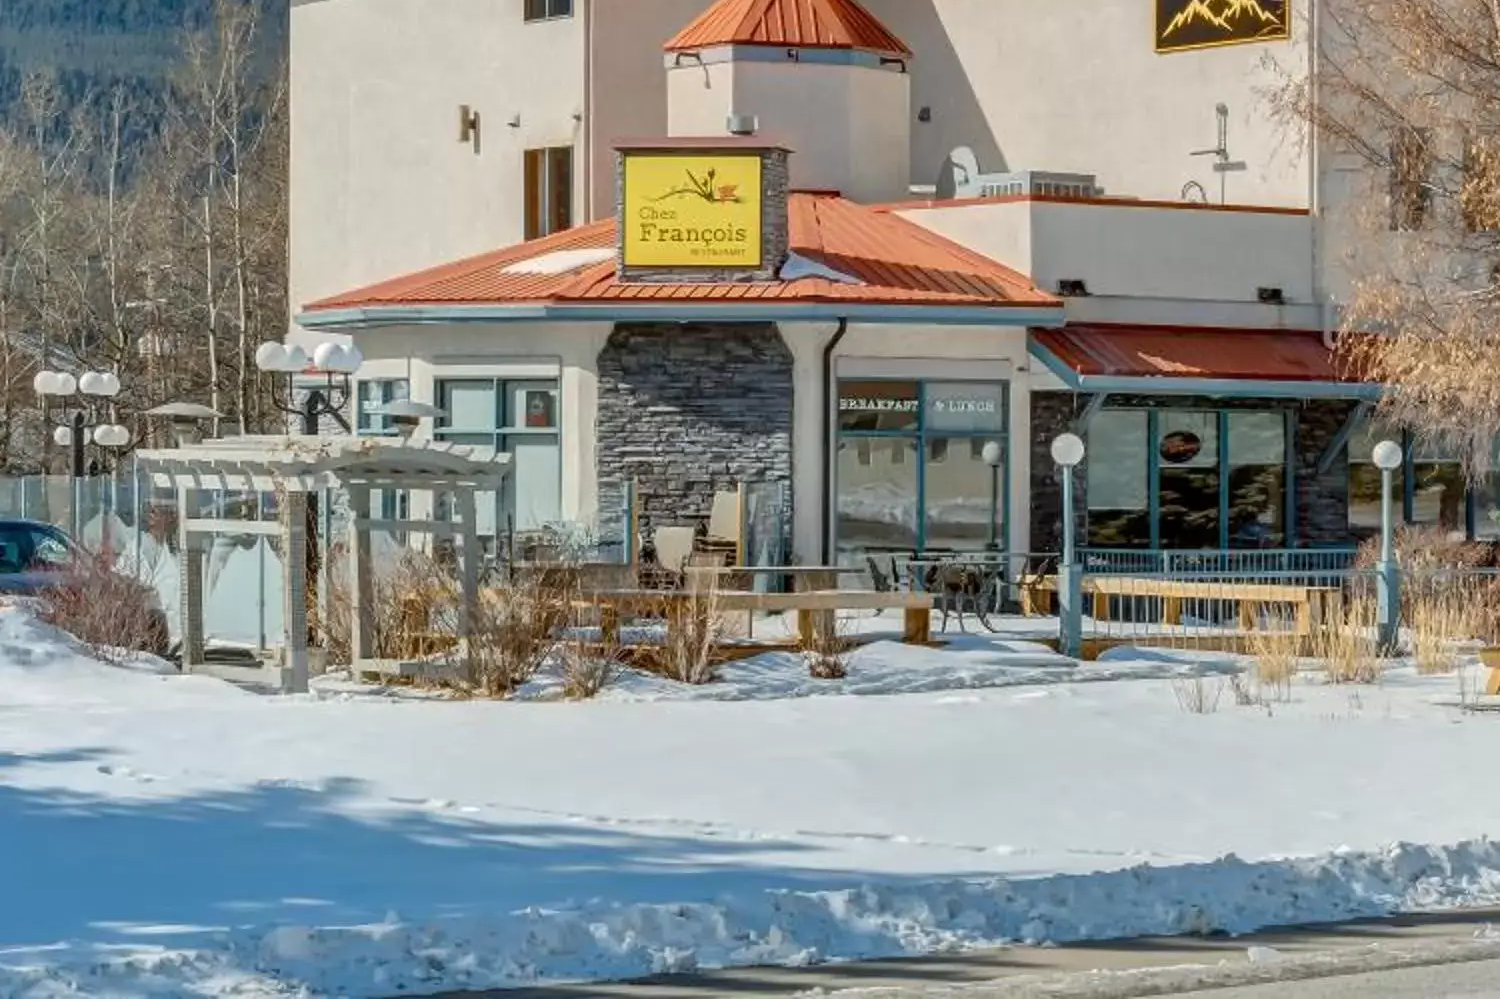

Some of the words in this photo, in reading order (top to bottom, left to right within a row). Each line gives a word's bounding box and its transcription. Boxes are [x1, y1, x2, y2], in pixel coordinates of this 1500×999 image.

[638, 205, 677, 220] Chez
[639, 222, 748, 246] François
[839, 398, 919, 411] BREAKFAST
[948, 400, 996, 413] LUNCH
